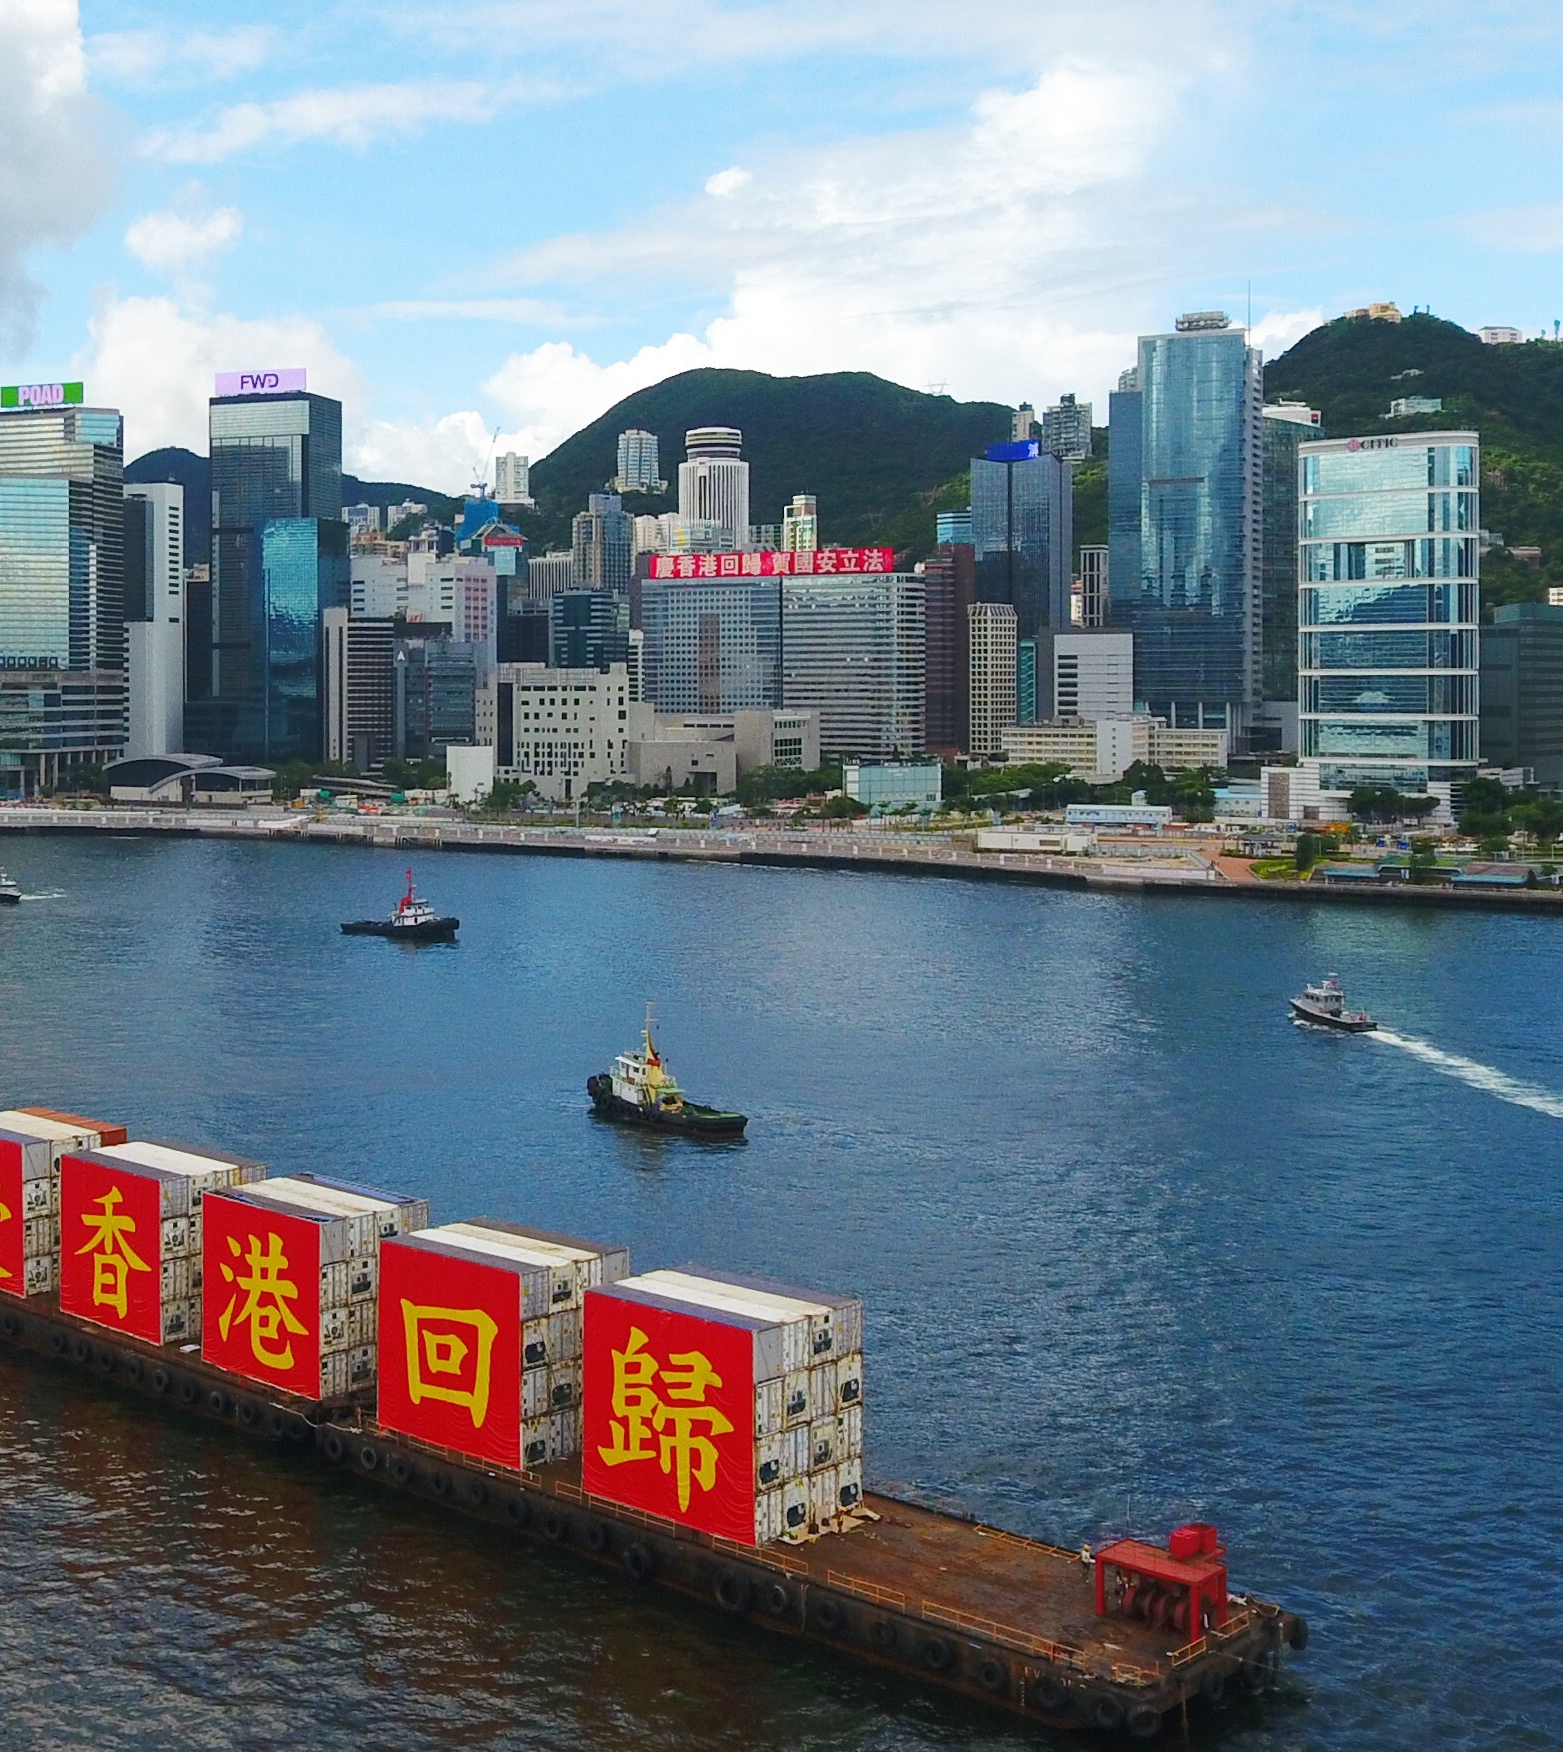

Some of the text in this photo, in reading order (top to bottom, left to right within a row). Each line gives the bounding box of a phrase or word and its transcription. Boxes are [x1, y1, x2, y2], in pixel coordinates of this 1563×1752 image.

[240, 373, 279, 390] FWD
[18, 384, 64, 406] POAD
[1361, 438, 1398, 449] CITIC
[655, 547, 884, 579] 慶香港回歸 賀國安立法
